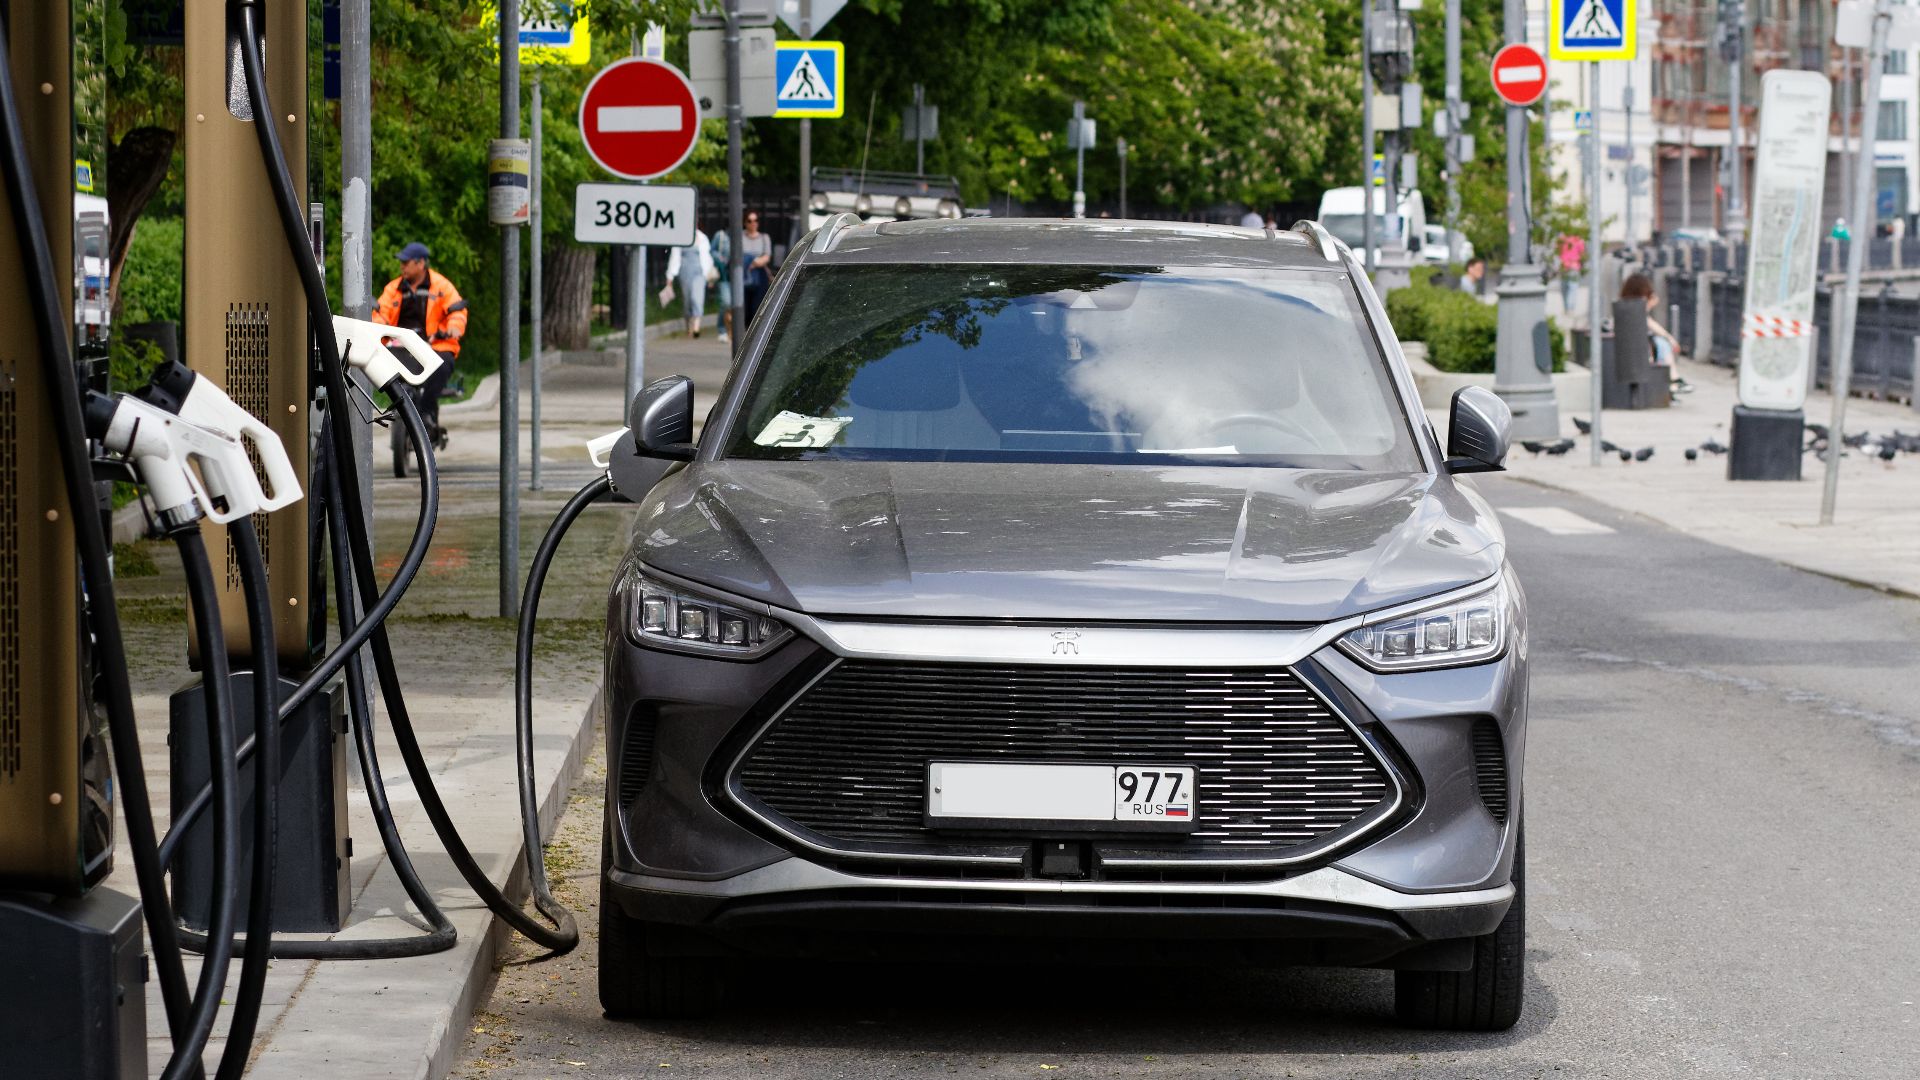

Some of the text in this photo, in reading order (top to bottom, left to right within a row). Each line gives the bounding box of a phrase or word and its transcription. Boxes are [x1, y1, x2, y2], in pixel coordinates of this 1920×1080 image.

[594, 200, 675, 229] 380м
[1118, 771, 1183, 803] 977
[1133, 803, 1164, 815] RUS
